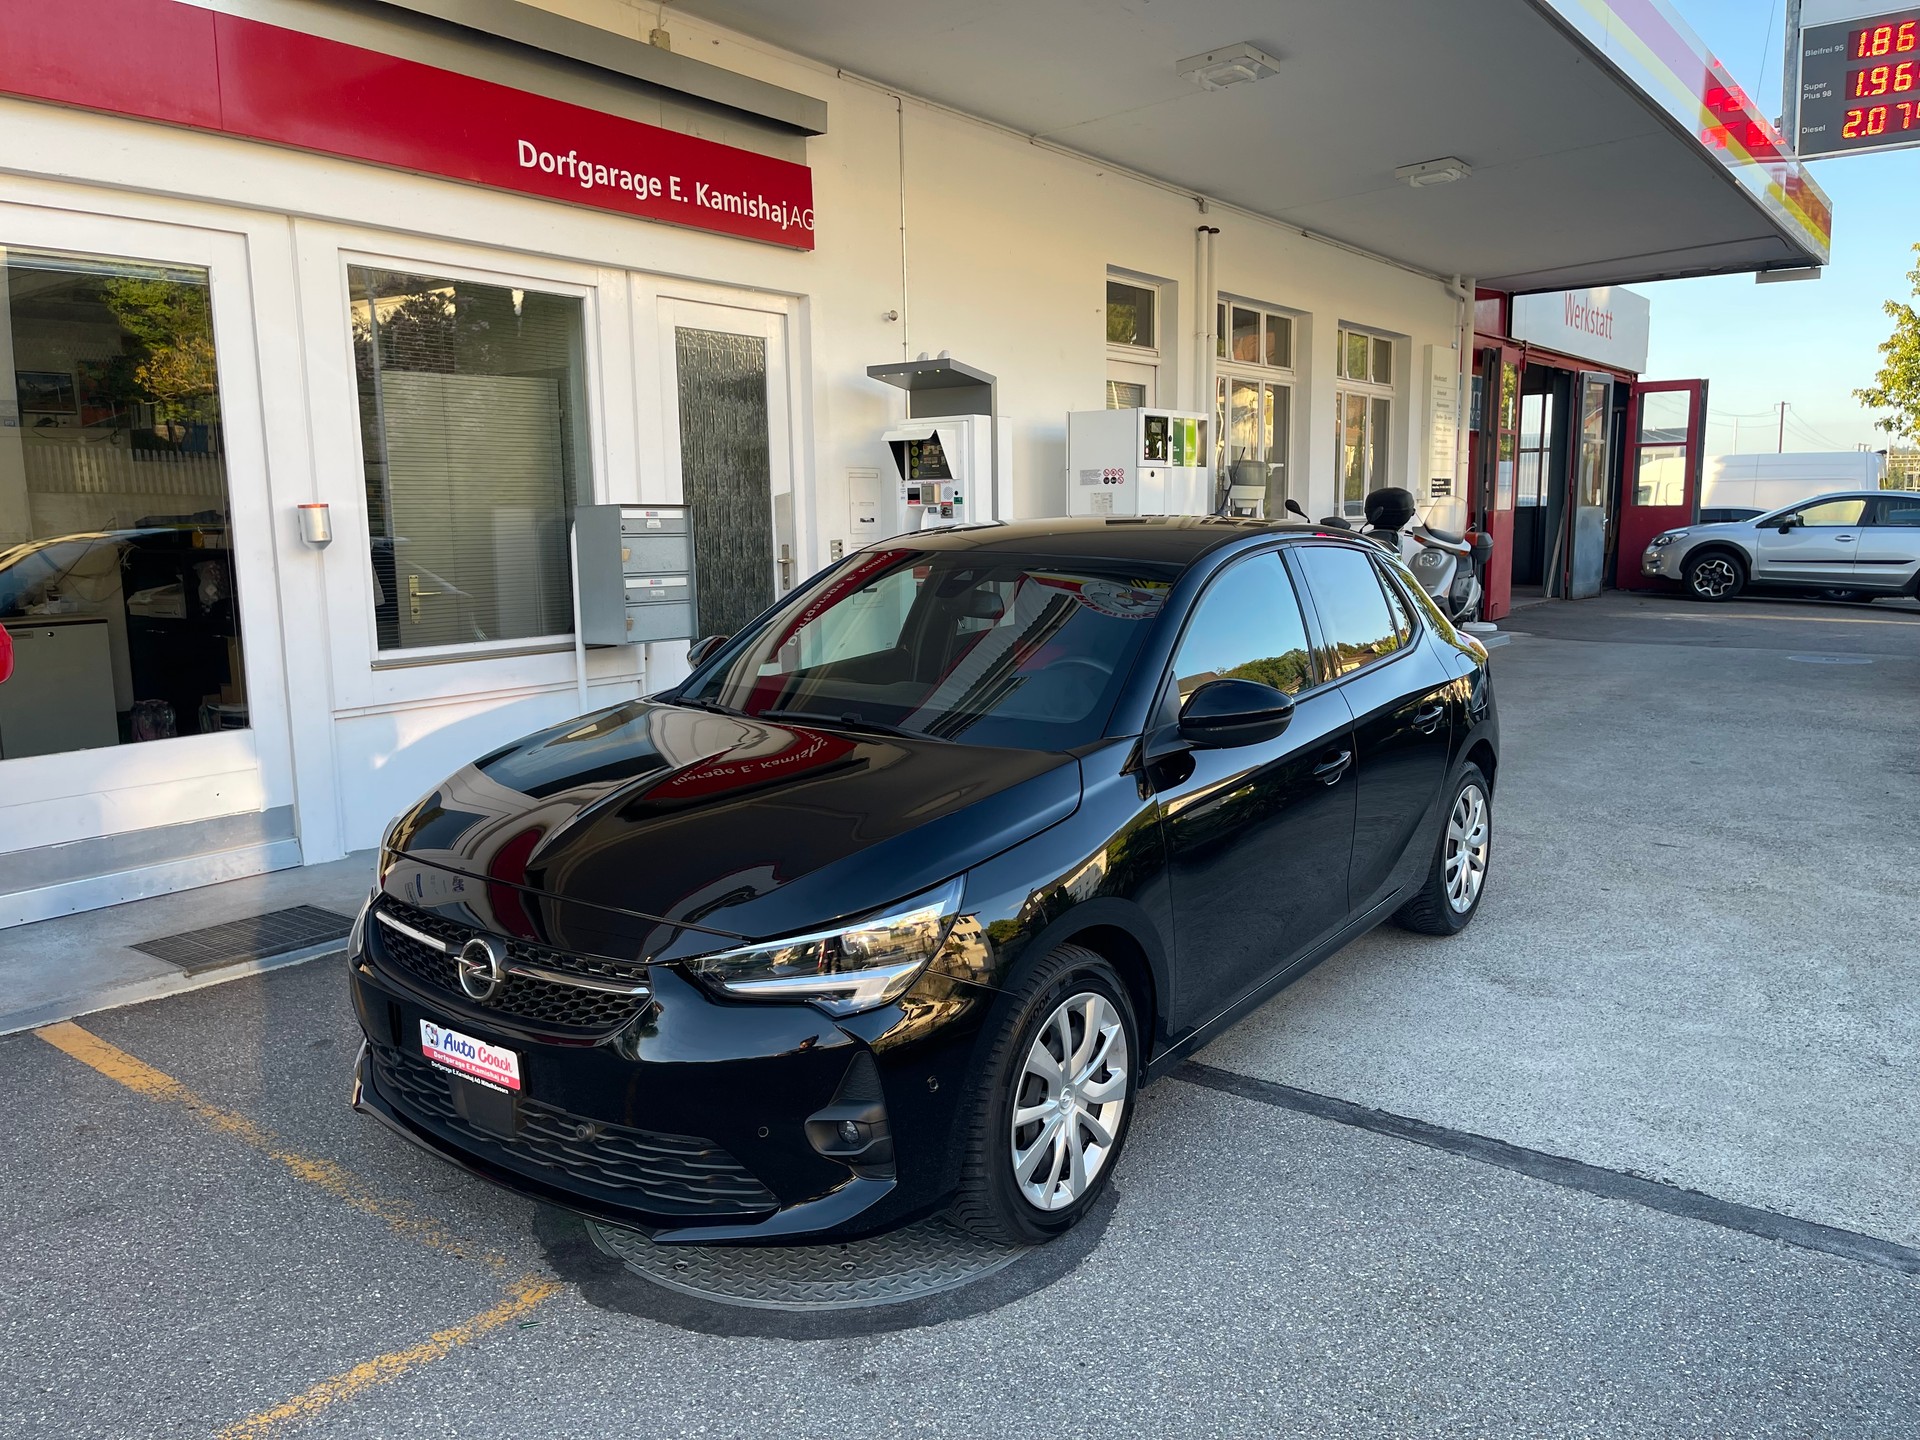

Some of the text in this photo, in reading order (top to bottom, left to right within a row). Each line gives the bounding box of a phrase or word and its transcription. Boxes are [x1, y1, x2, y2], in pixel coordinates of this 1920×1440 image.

[1805, 44, 1844, 57] Bleifrei 95
[1803, 82, 1827, 91] Super
[1822, 90, 1832, 98] 98
[1801, 124, 1826, 134] Diesel
[1841, 101, 1920, 139] 2.07
[518, 139, 662, 200] Dorfgarage
[669, 176, 688, 203] E.
[1564, 291, 1613, 340] Werkstatt
[433, 1051, 465, 1069] Dorfgarage
[444, 1033, 513, 1073] Auto Coach
